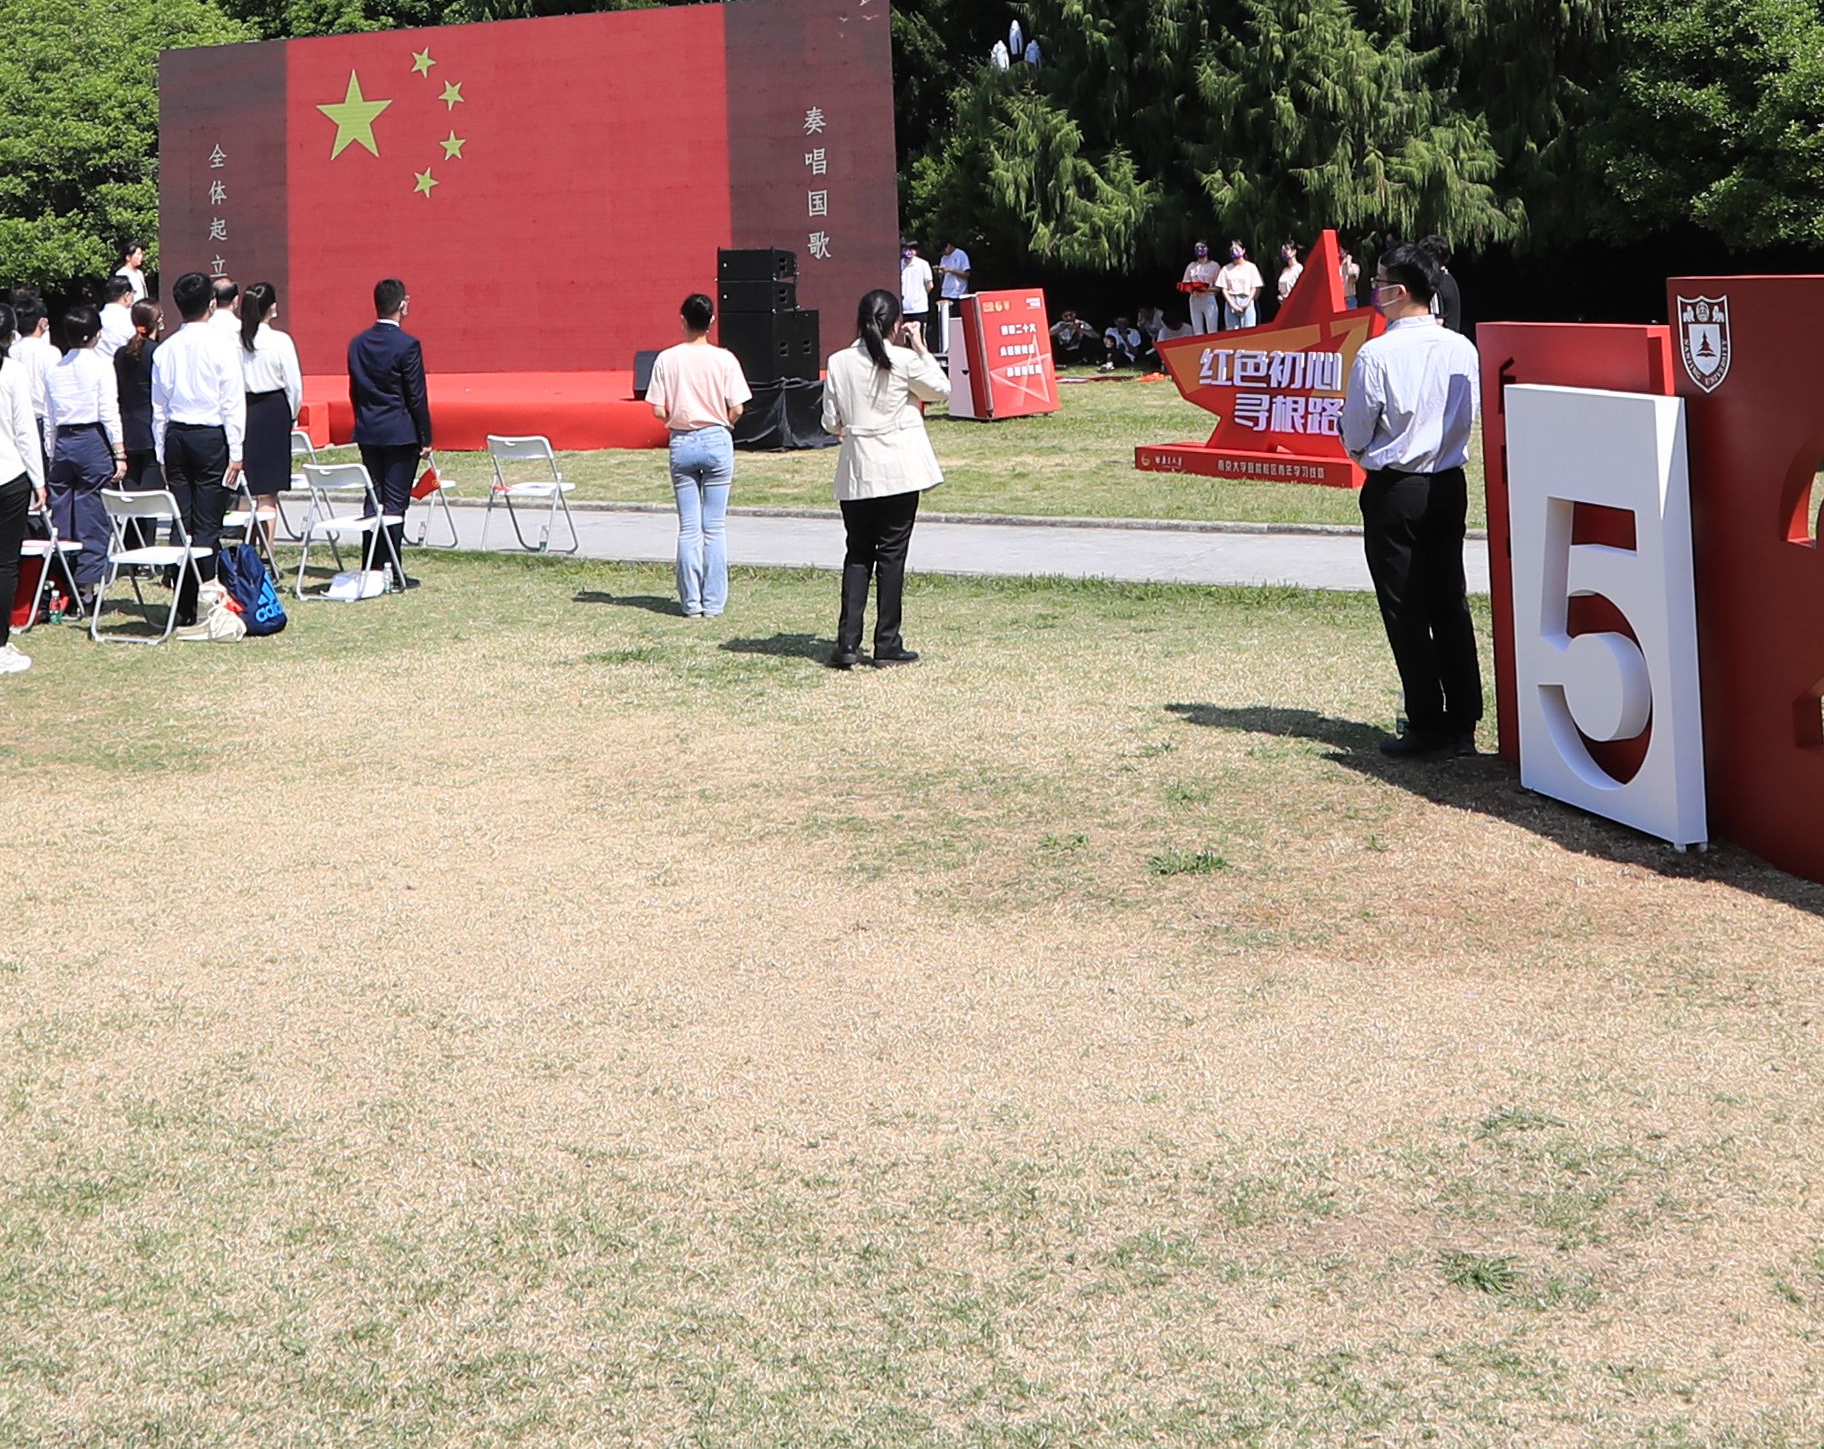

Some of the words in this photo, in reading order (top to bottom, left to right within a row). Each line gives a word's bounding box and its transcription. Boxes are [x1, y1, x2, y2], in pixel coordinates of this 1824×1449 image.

[208, 143, 228, 278] 全体起立
[803, 106, 832, 260] 奏唱国歌
[1199, 348, 1343, 391] 红色初心
[1234, 393, 1344, 436] 寻根路
